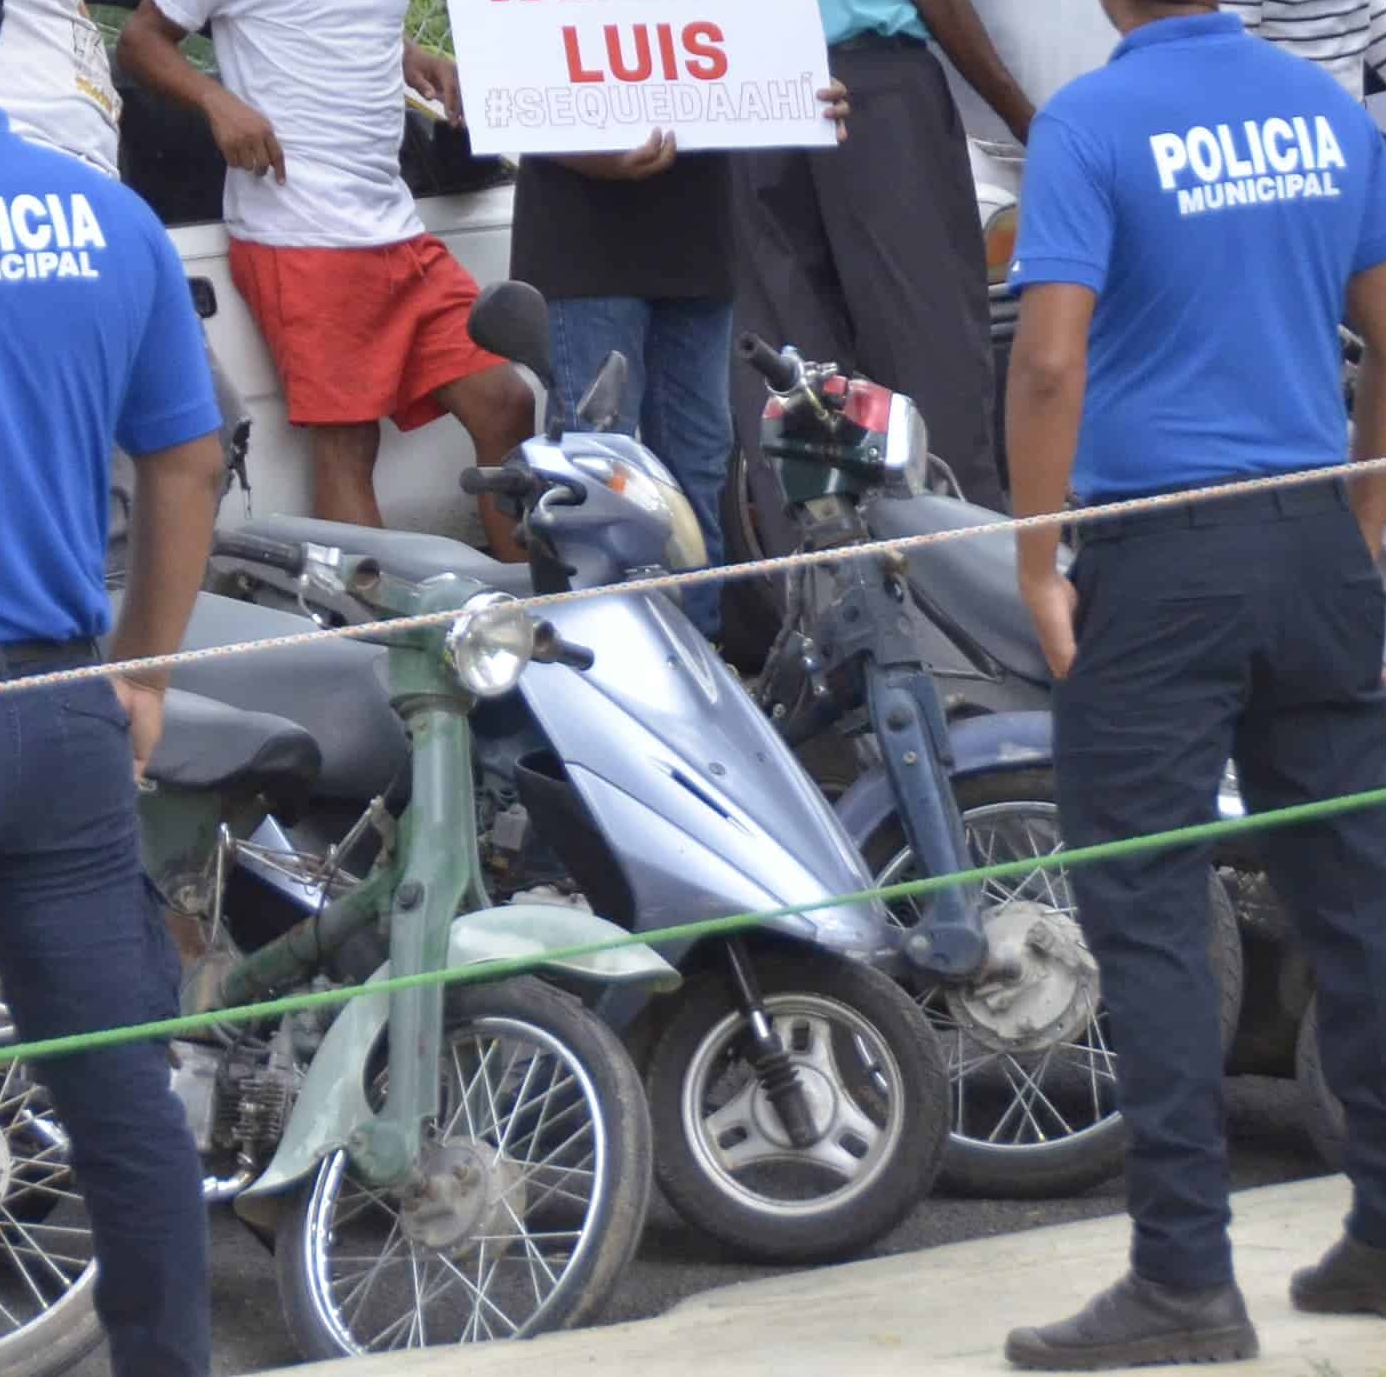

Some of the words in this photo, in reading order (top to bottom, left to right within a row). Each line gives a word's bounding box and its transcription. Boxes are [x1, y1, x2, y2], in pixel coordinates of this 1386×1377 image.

[561, 20, 729, 84] LUIS
[1148, 115, 1348, 190] POLICIA
[1176, 170, 1341, 216] MUNICIPAL
